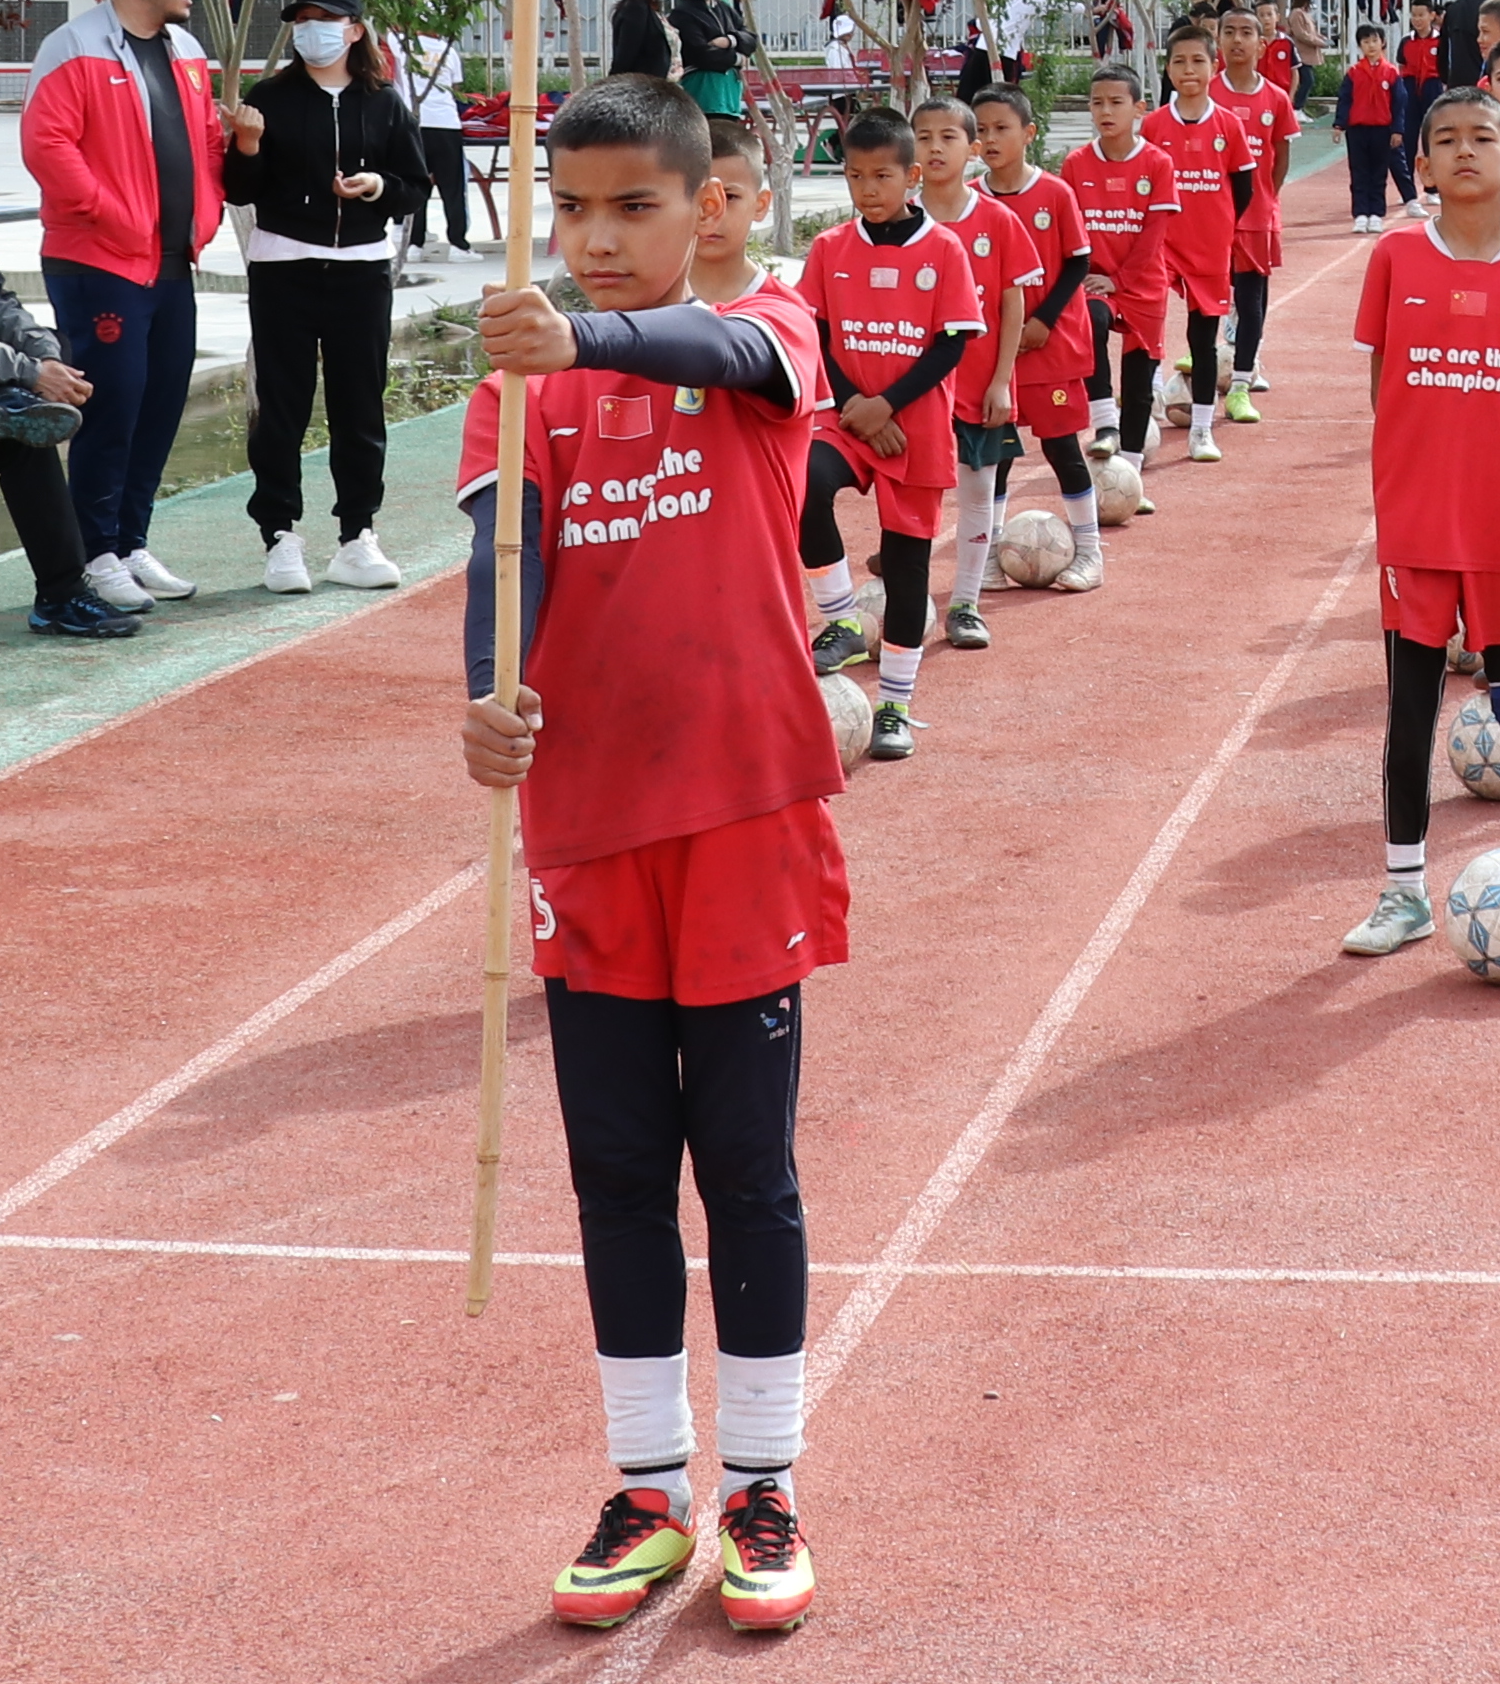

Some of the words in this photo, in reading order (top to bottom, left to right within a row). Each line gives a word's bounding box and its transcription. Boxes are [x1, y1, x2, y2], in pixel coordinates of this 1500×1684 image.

[1182, 169, 1201, 180] are
[1203, 168, 1221, 180] the
[1175, 180, 1222, 193] ampions
[1084, 208, 1103, 219] we
[1104, 208, 1125, 219] are
[1126, 208, 1145, 220] the
[867, 320, 896, 334] are
[898, 320, 927, 339] the
[1409, 347, 1443, 363] we
[1446, 348, 1481, 365] are
[601, 473, 658, 504] are
